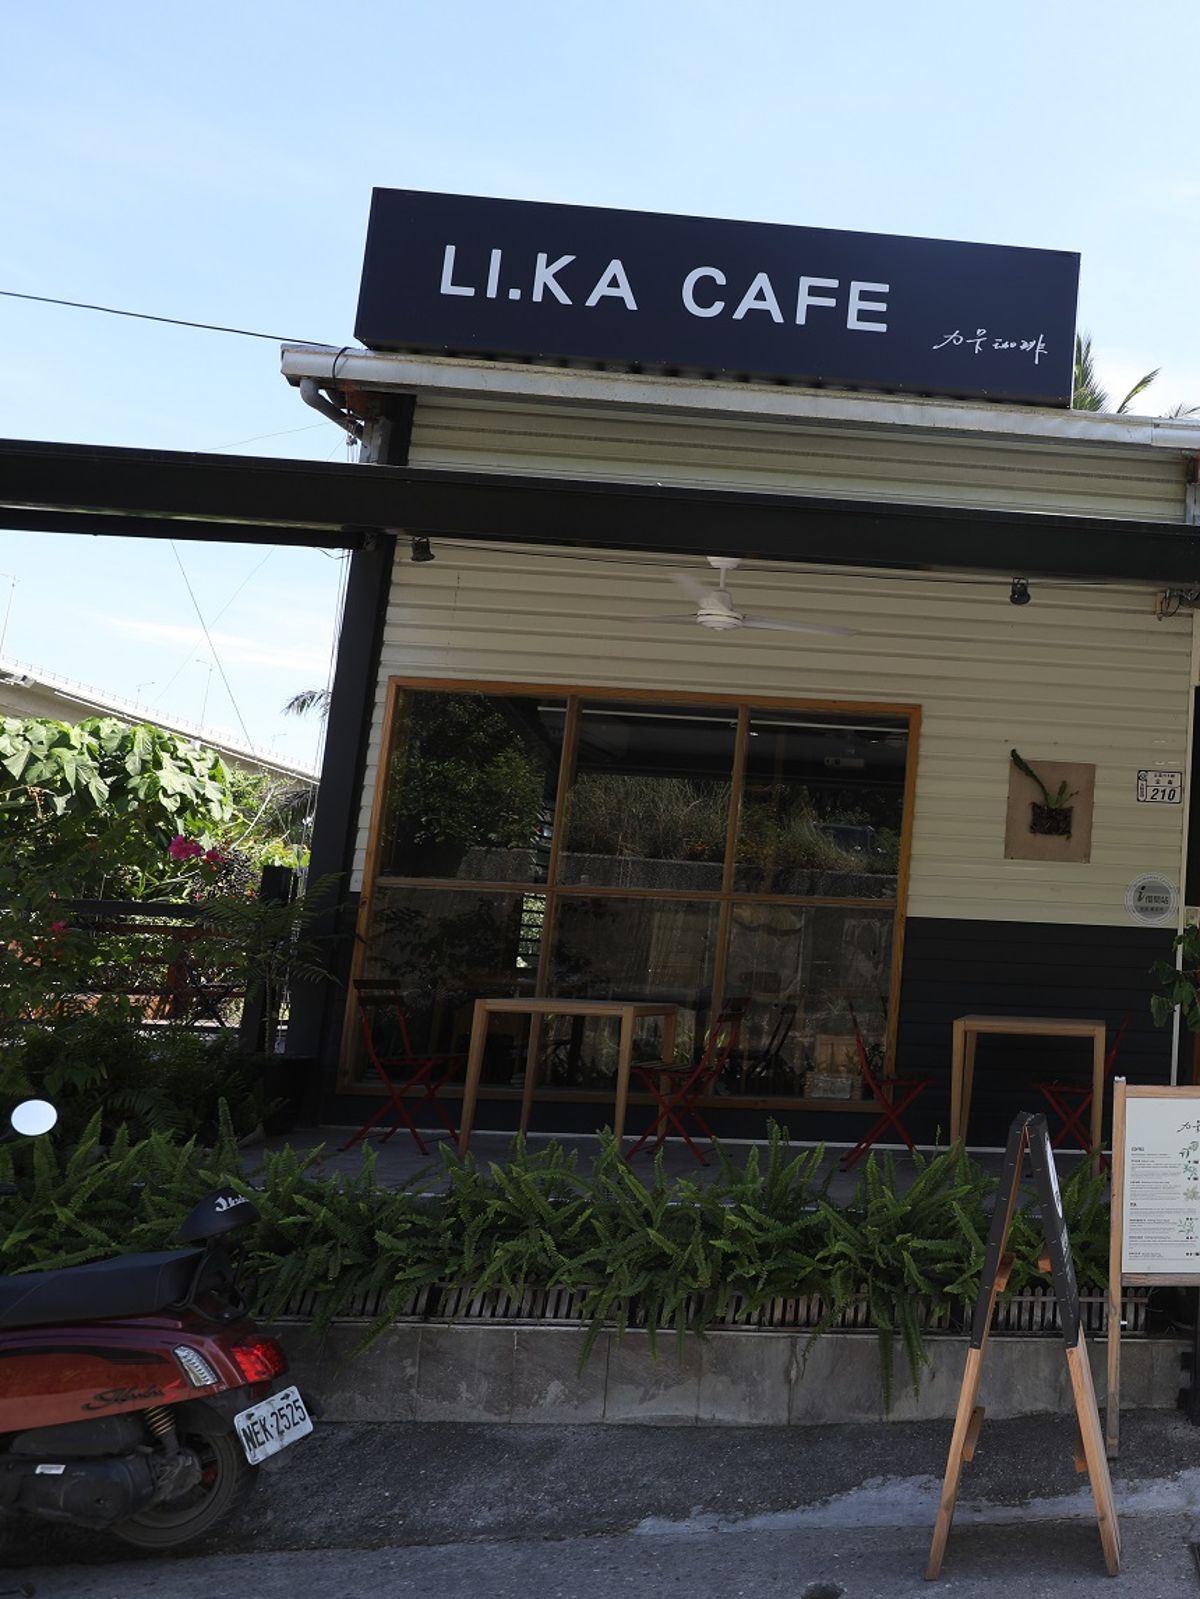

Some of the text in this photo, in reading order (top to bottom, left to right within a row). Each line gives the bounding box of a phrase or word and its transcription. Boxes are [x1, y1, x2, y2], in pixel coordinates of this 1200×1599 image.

[439, 244, 890, 333] LI.KA CAFE
[1150, 787, 1176, 802] 210
